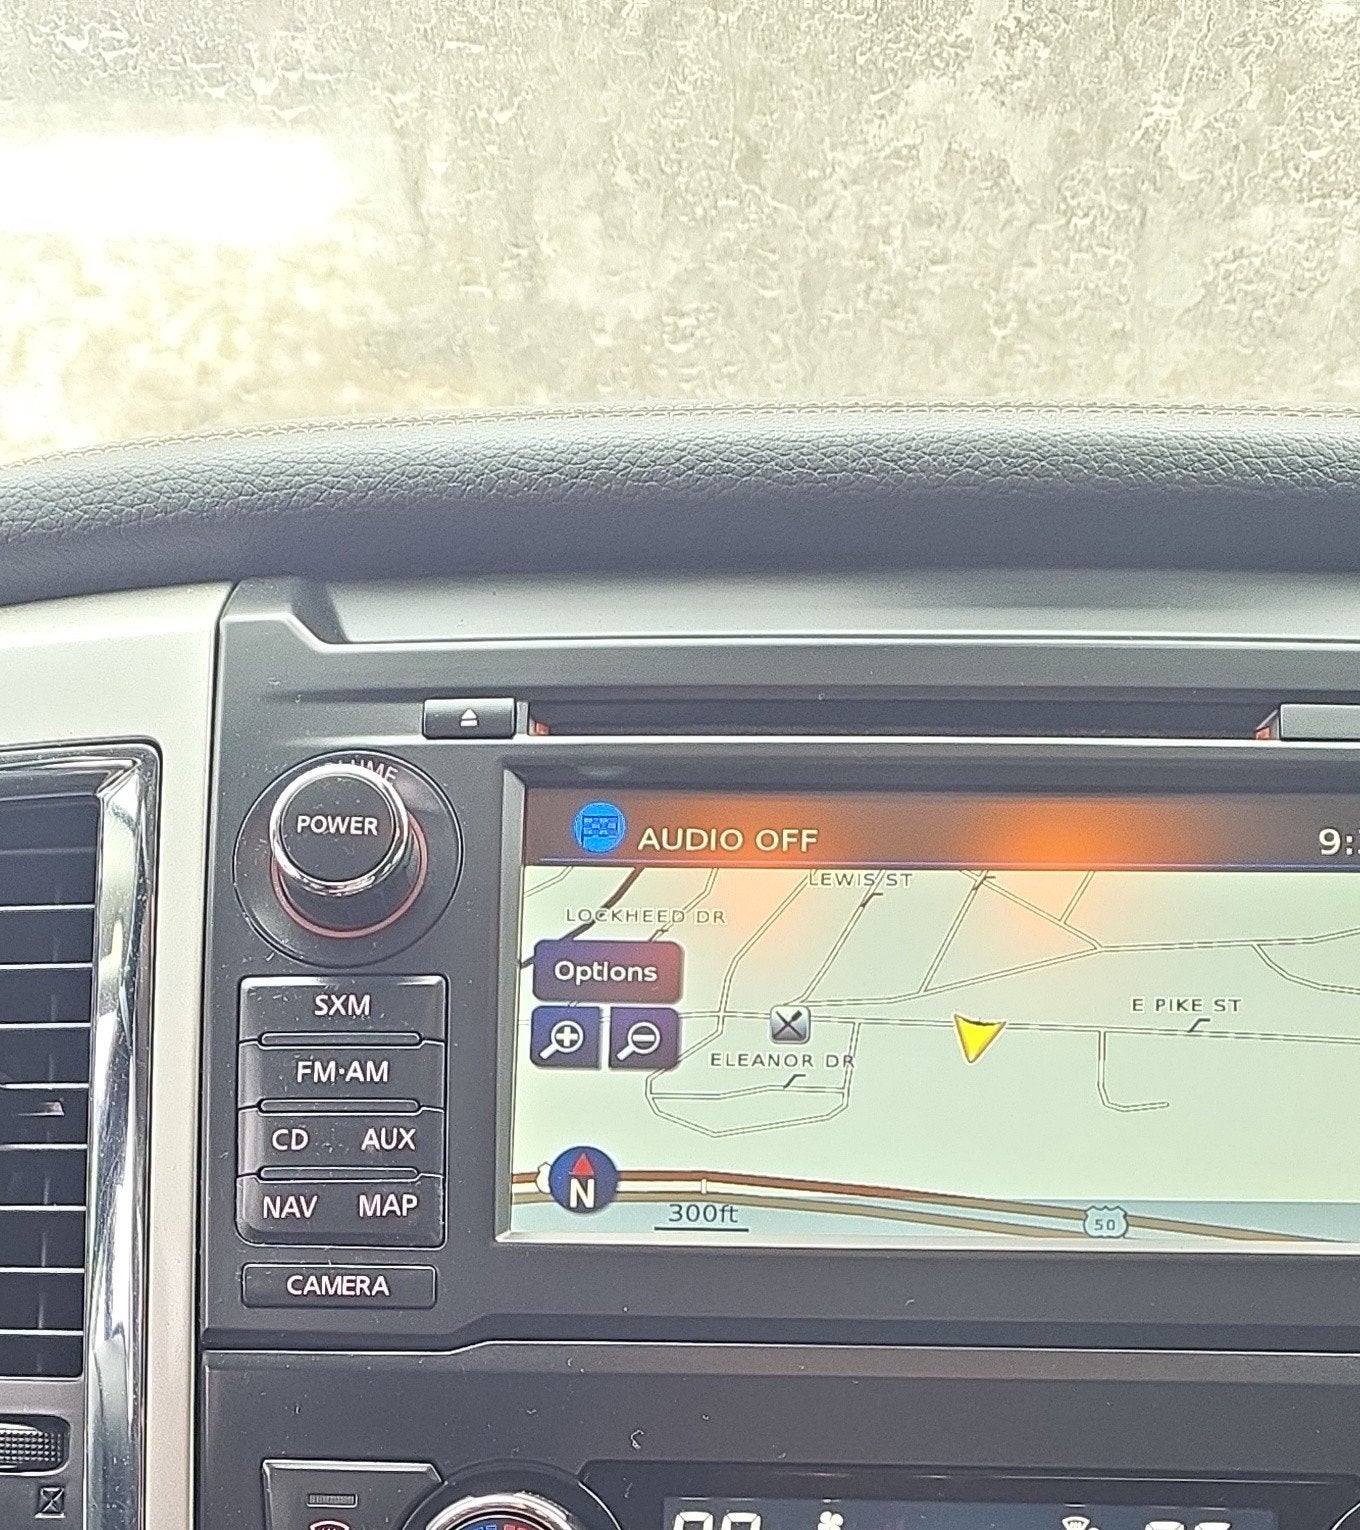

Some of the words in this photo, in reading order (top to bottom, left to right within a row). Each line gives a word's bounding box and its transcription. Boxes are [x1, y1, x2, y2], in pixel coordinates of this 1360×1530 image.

[296, 815, 378, 836] POWER
[638, 828, 744, 852] AUDIO
[756, 829, 820, 853] OFF
[809, 872, 875, 887] LEWIS
[886, 872, 914, 887] ST
[565, 908, 686, 924] LOCKHEED
[696, 909, 727, 924] DR
[554, 960, 658, 985] Options
[314, 994, 371, 1016] SXM
[1132, 998, 1143, 1013] E
[1155, 998, 1203, 1013] PIKE
[1213, 998, 1242, 1013] ST
[710, 1053, 814, 1068] ELEANOR
[826, 1054, 855, 1068] DR
[272, 1128, 309, 1150] CD
[361, 1128, 416, 1150] AUX
[568, 1178, 595, 1209] N
[262, 1195, 318, 1219] NAV
[358, 1194, 418, 1217] MAP
[668, 1204, 739, 1225] 300ft
[1093, 1218, 1116, 1232] 50
[286, 1274, 390, 1296] CAMERA
